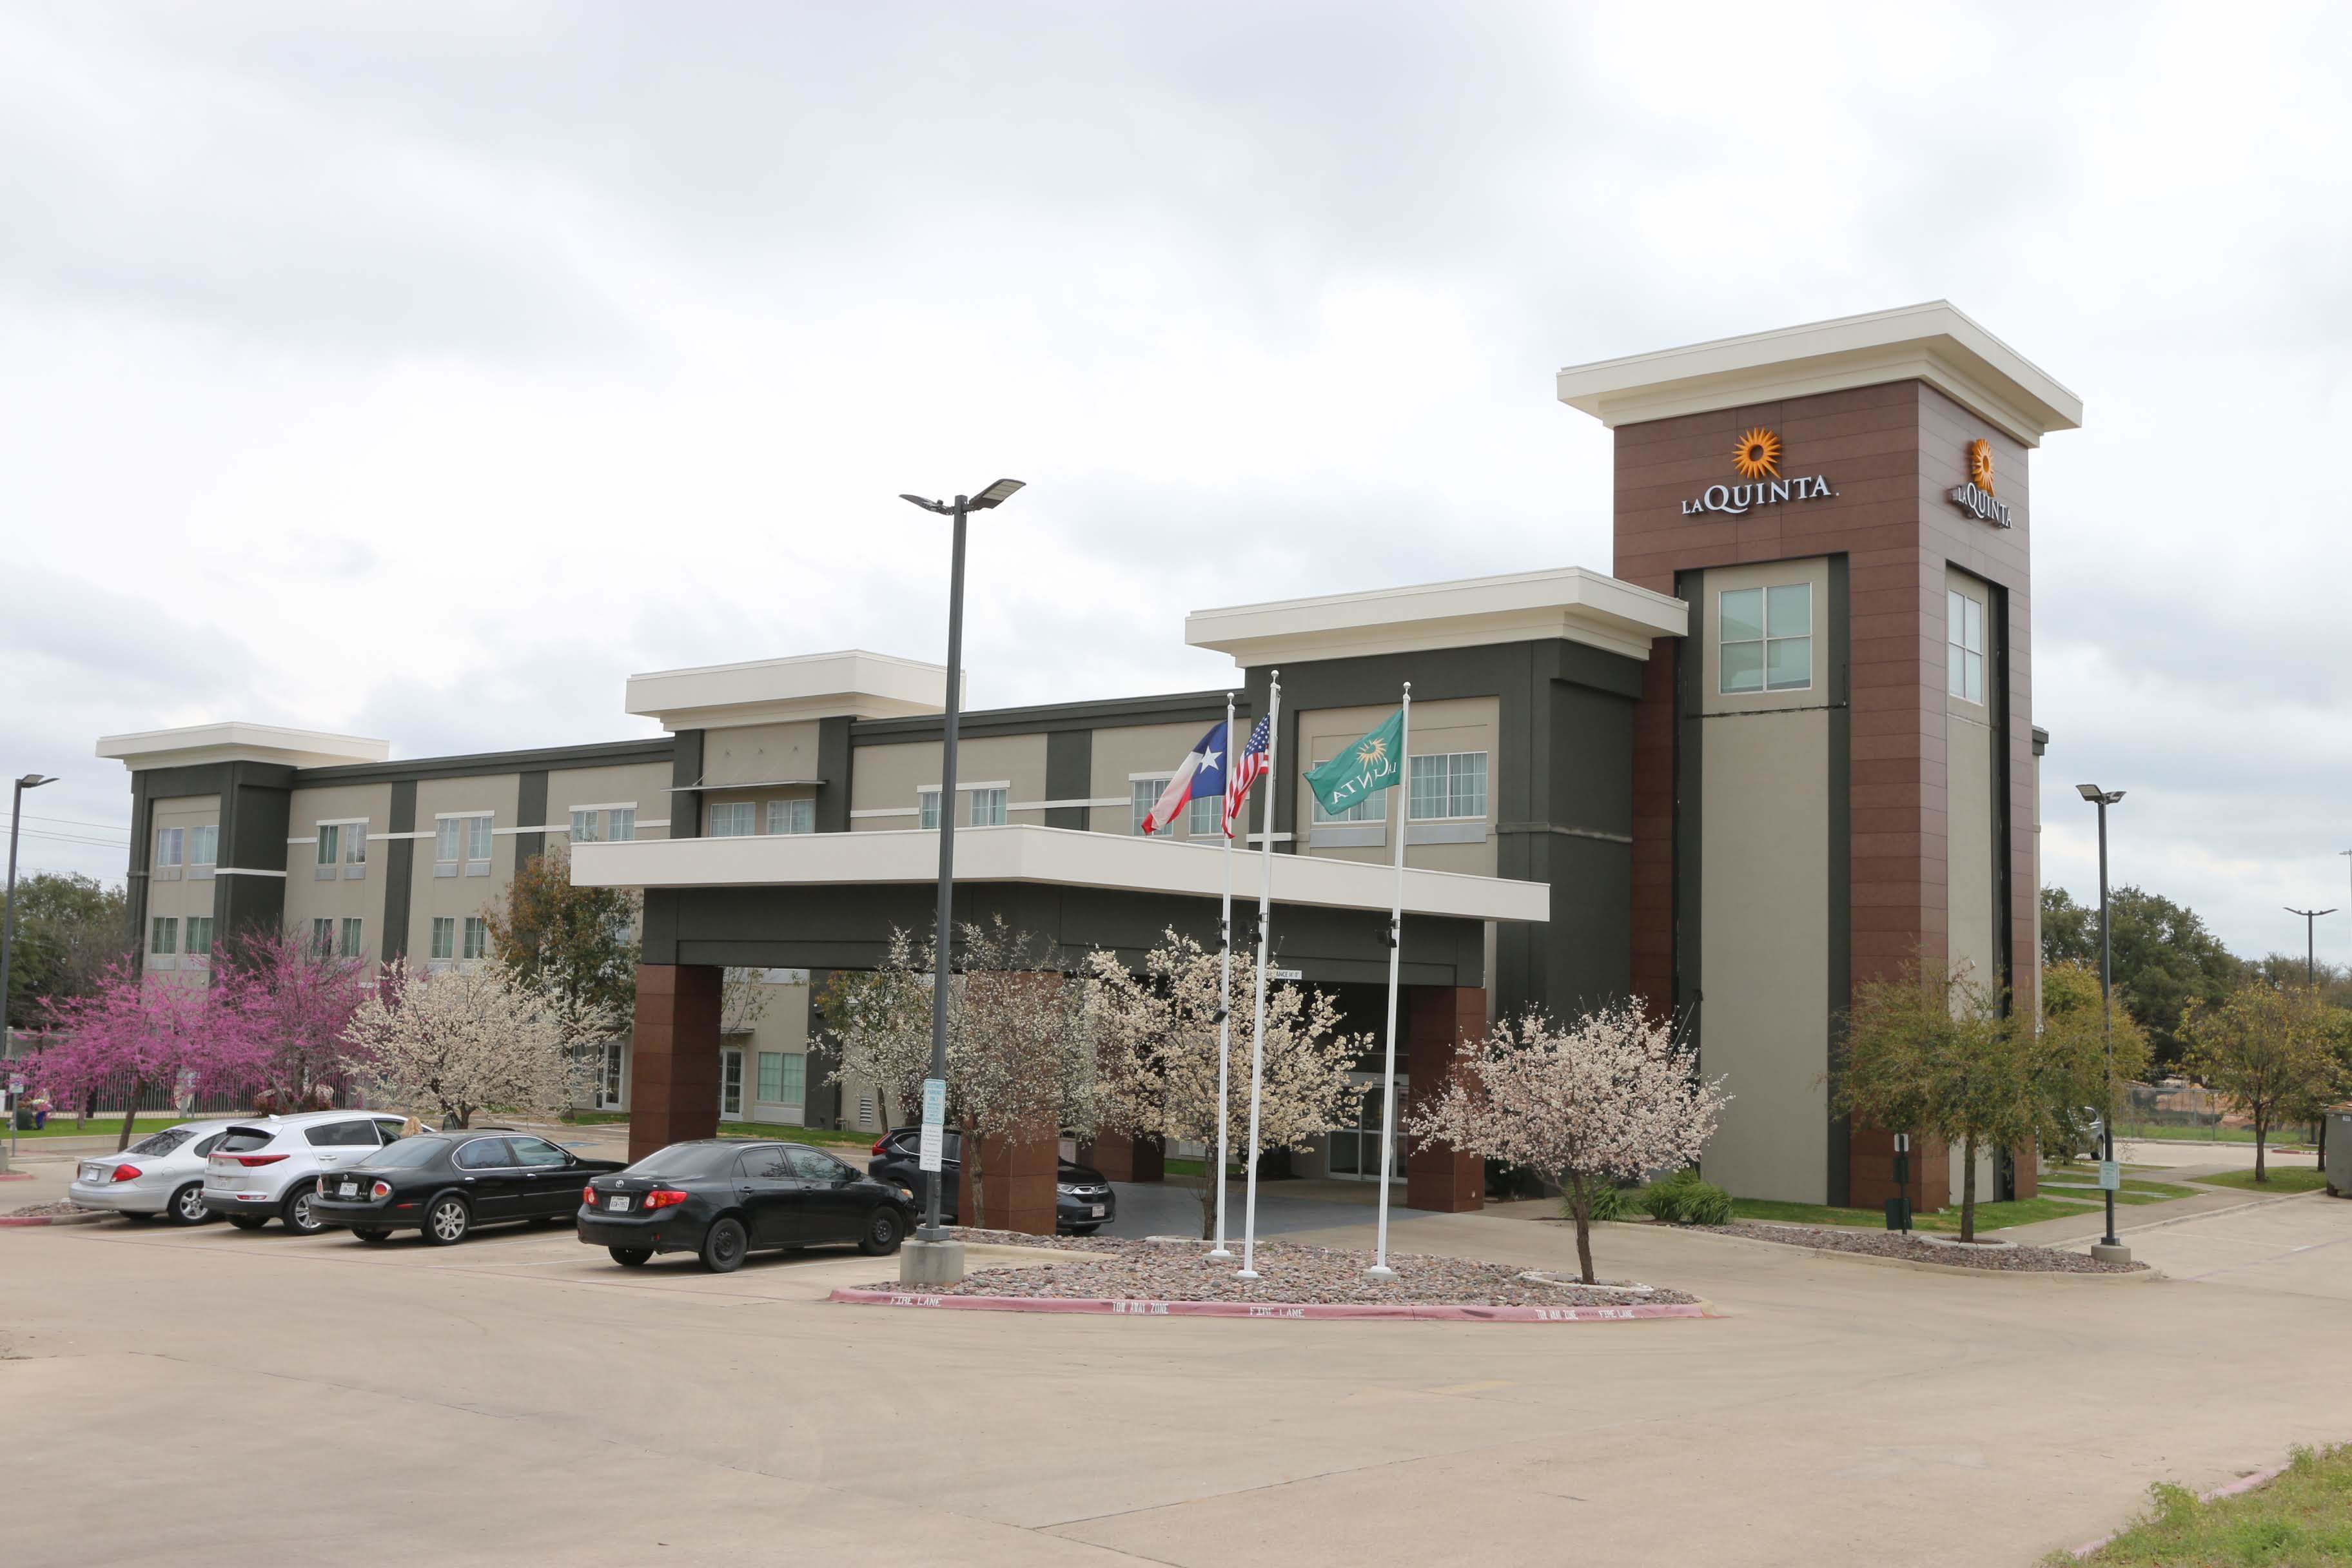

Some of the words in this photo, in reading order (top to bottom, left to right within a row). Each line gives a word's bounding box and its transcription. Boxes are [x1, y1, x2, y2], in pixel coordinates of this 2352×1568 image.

[1681, 498, 1704, 514] LA
[1703, 475, 1832, 514] QUINTA
[1958, 487, 1968, 505] LA
[1966, 482, 2012, 529] QUINTA
[890, 1296, 914, 1305] FIRE
[917, 1297, 942, 1306] LANE
[1112, 1301, 1126, 1313] TOW
[1130, 1302, 1145, 1313] AWAY
[1150, 1302, 1169, 1314] ZONE
[1250, 1306, 1275, 1316] FIRE
[1279, 1308, 1305, 1318] LANE
